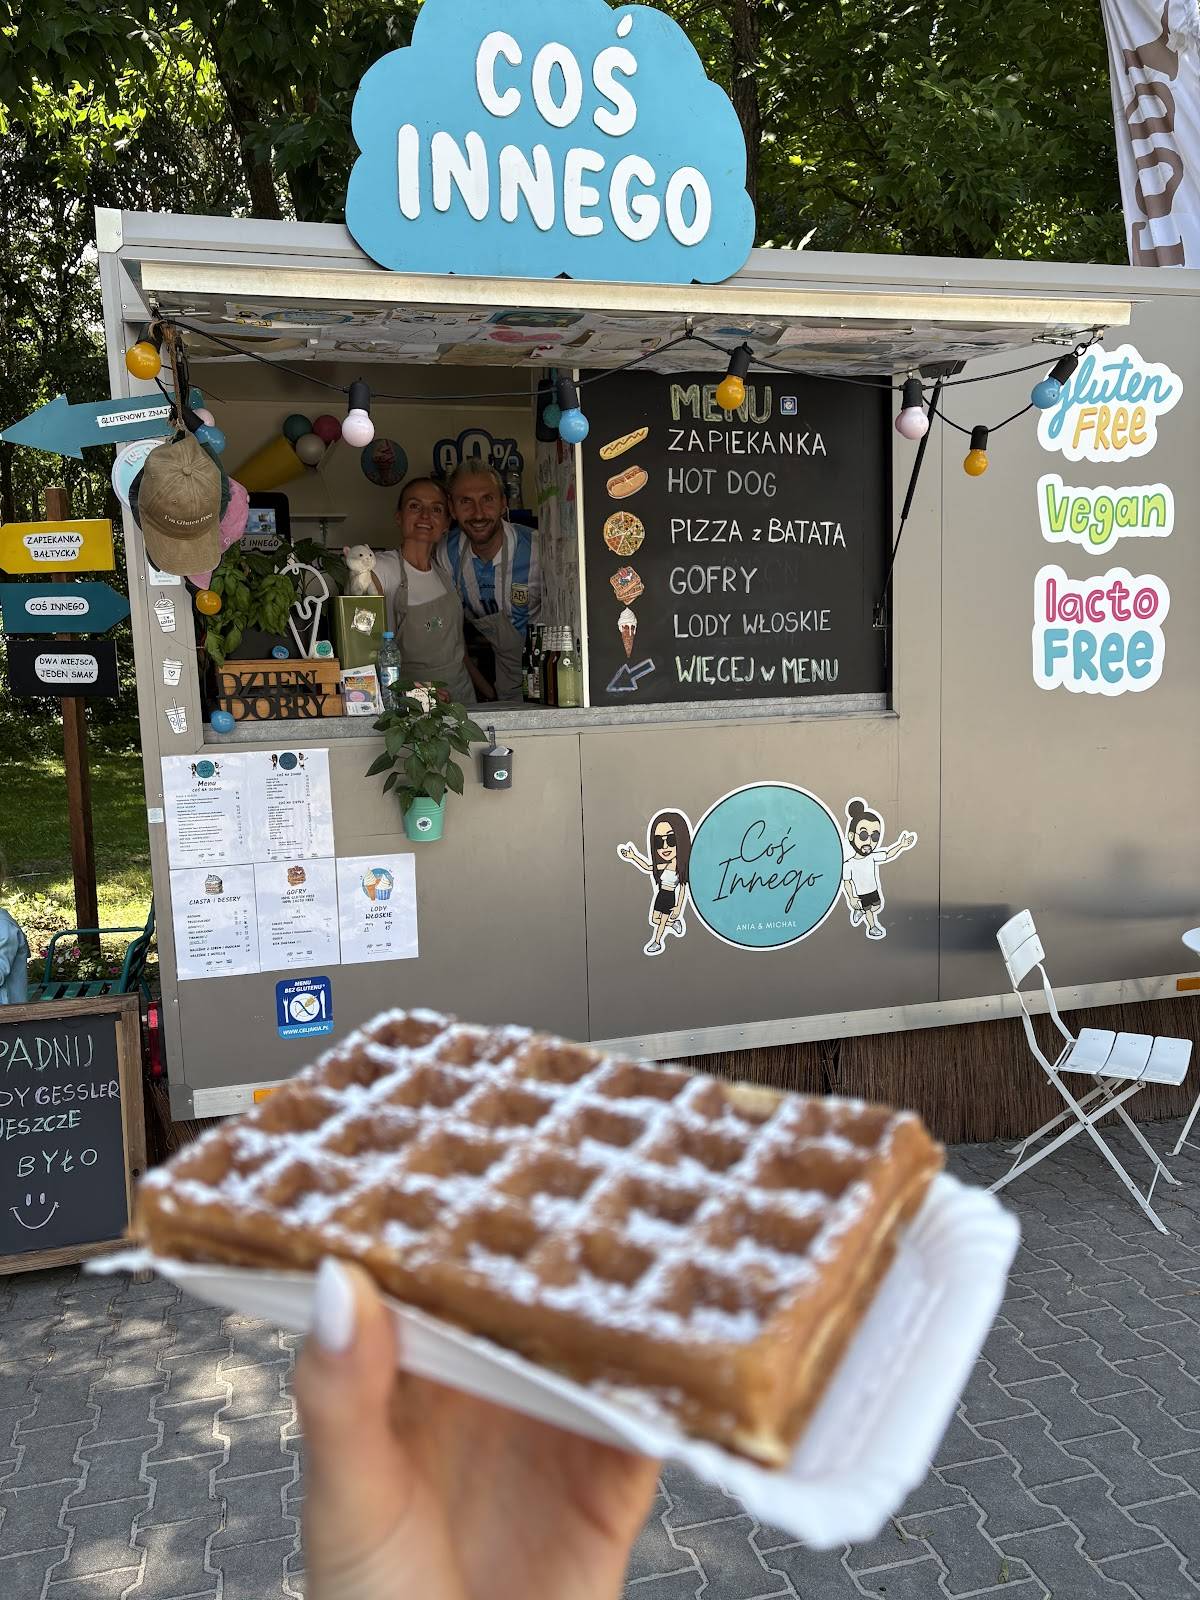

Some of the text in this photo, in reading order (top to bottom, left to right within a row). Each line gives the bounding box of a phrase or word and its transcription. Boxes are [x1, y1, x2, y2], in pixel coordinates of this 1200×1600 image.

[475, 13, 639, 137] COŚ
[397, 123, 713, 247] INNEGO
[668, 383, 773, 424] MENU
[1047, 354, 1174, 439] gluten
[101, 411, 146, 424] GLUTENOWI
[667, 428, 827, 457] ZAPIEKANKA
[667, 467, 778, 498] HOT DOG
[26, 535, 81, 545] ZAPIEKANKA
[249, 539, 279, 547] INNEGO
[669, 518, 743, 545] PIZZA
[767, 517, 848, 551] BATATA
[33, 549, 77, 558] BAŁTYCKA
[668, 565, 758, 595] GOFRY
[30, 601, 85, 611] COŚ INNEGO
[1045, 578, 1159, 624] lacto
[673, 609, 832, 639] LODY WŁOSKIE
[39, 657, 94, 666] DWA MIEJSCA
[40, 669, 94, 679] JEDEN SMAK
[674, 655, 754, 686] WIĘCEJ
[780, 656, 839, 685] MENU
[218, 693, 330, 720] DOBRY
[740, 819, 798, 865] Coś
[712, 855, 823, 914] Innego
[188, 898, 211, 906] CIASTA
[365, 911, 393, 920] WŁOSKIE
[736, 923, 756, 931] ANIA
[757, 922, 763, 930] &
[34, 1079, 121, 1106] GESSLER
[0, 1109, 82, 1141] JESZCZE
[17, 1148, 98, 1178] BYŁO
